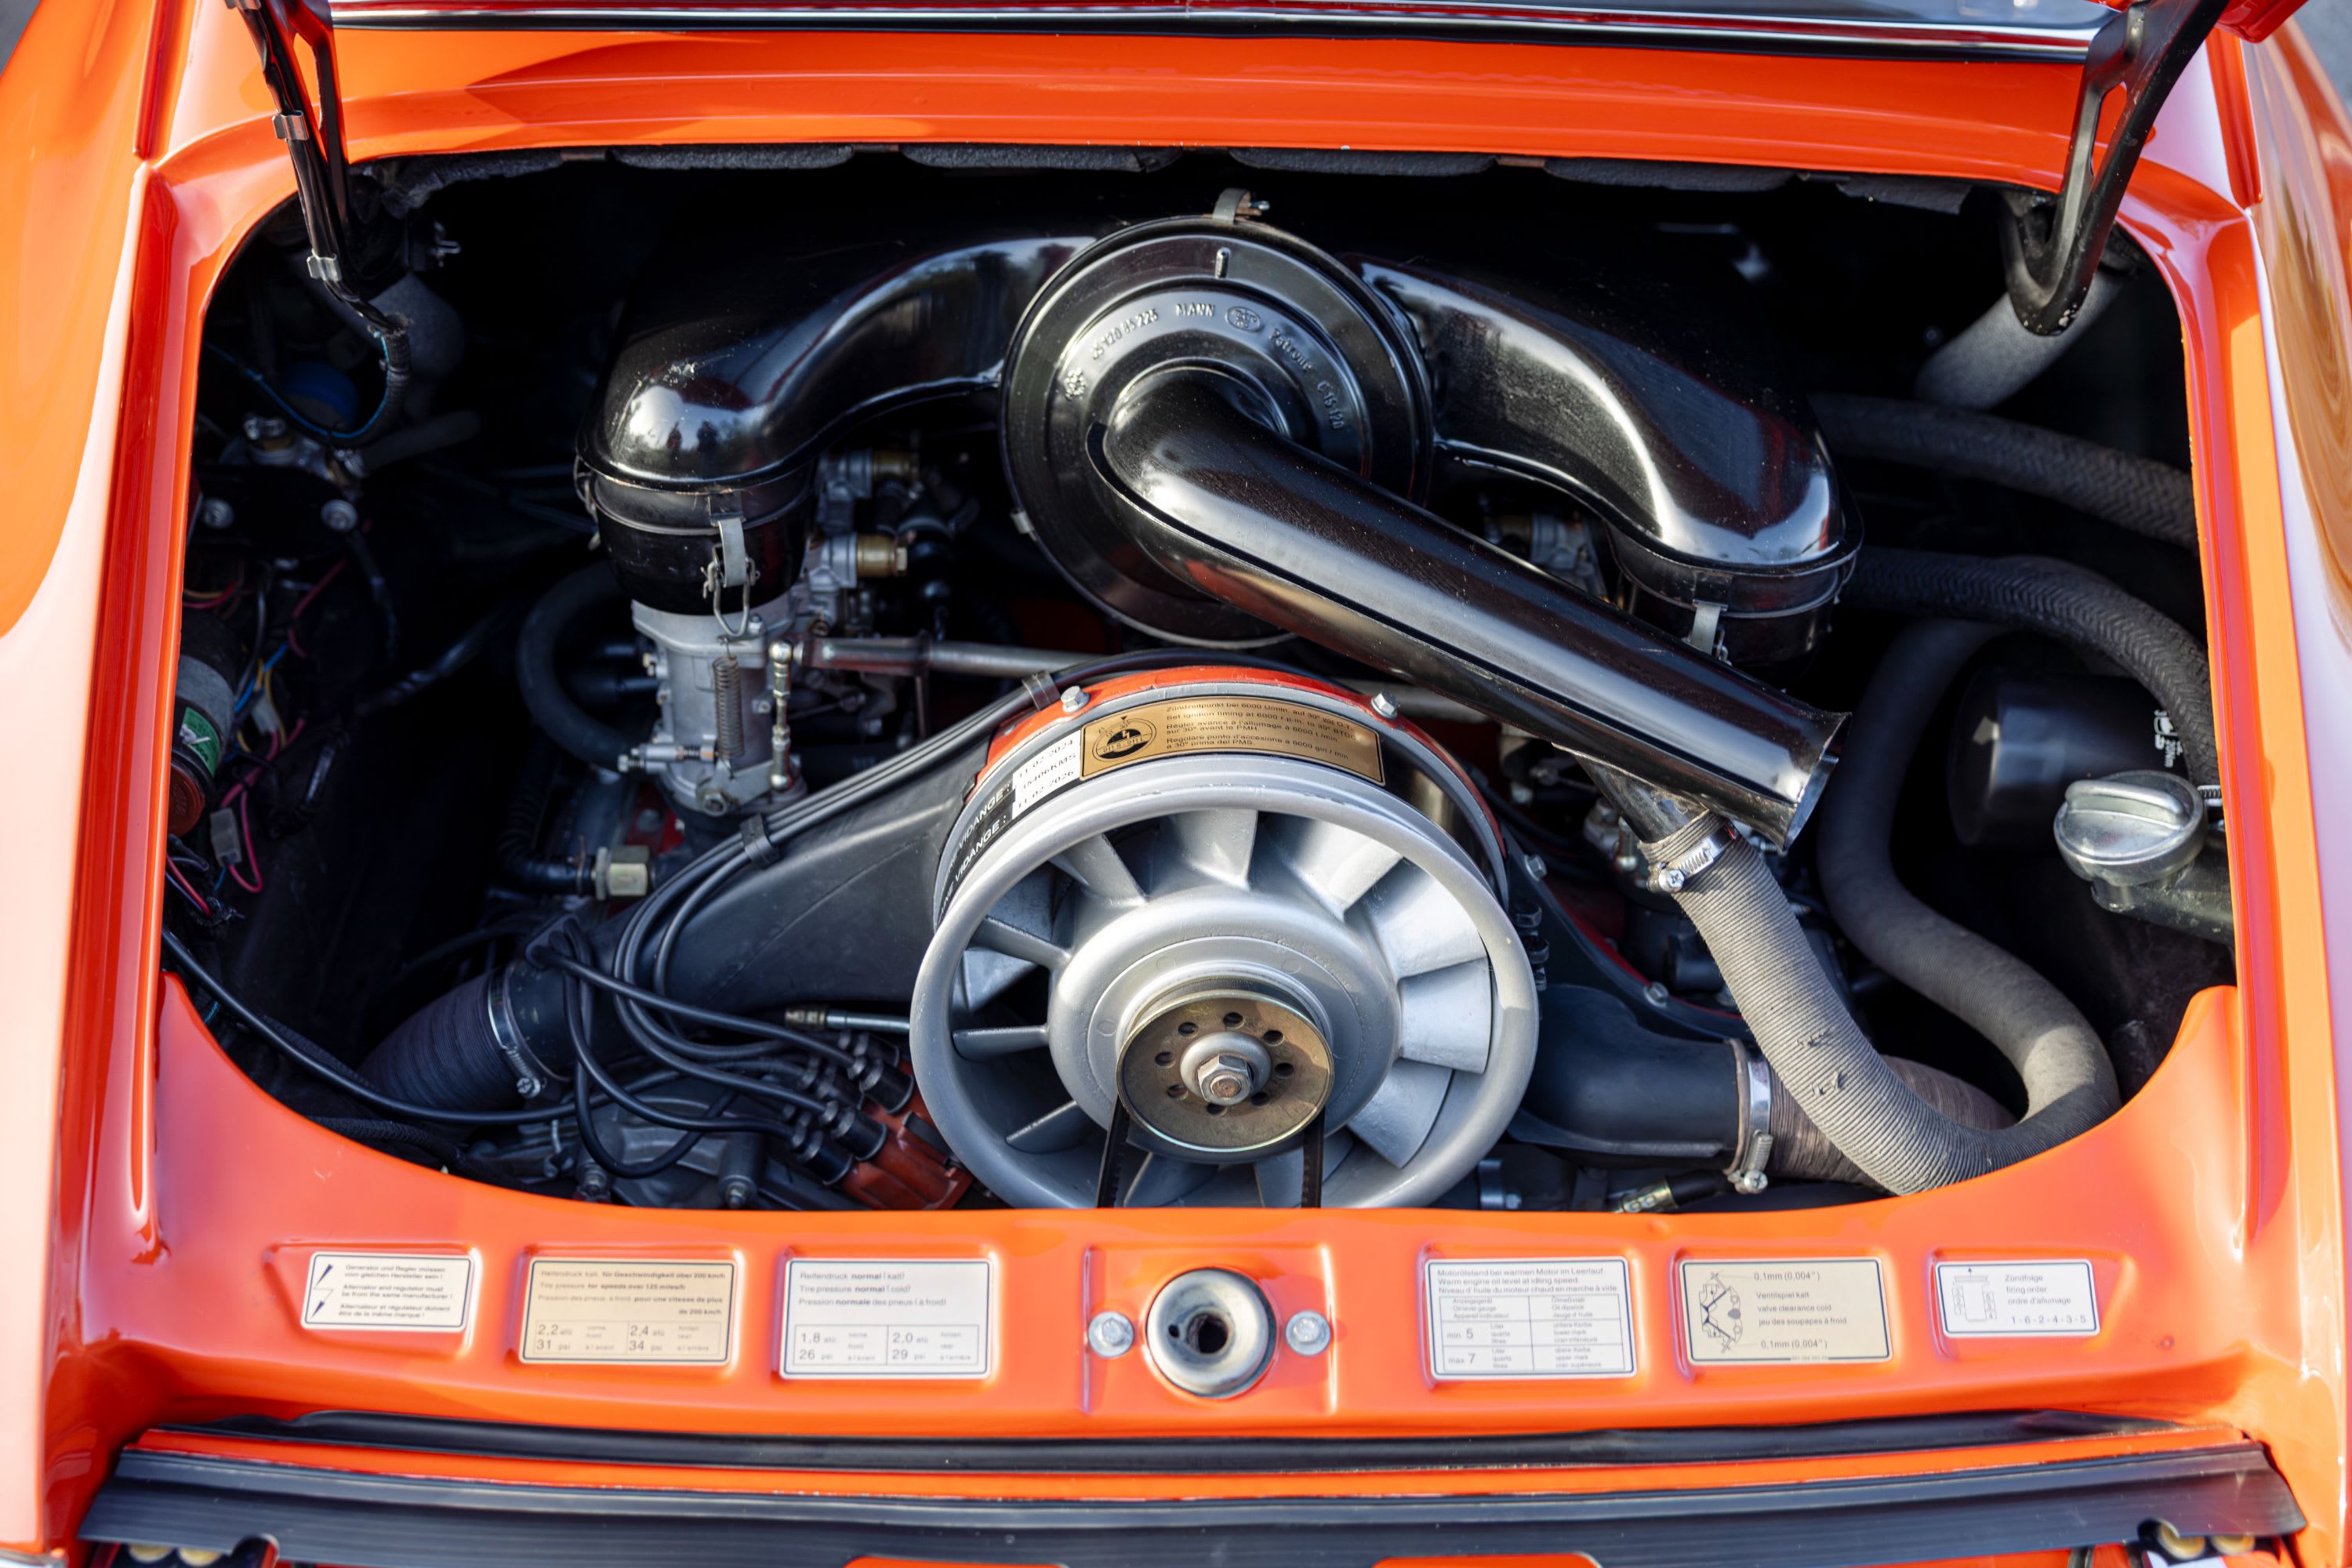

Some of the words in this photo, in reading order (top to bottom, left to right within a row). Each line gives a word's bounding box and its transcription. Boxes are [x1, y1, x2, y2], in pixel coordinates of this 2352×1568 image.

[1176, 303, 1215, 318] MANN
[2005, 1274, 2043, 1283] Zündfolge
[2006, 1285, 2026, 1294] firing
[1756, 1291, 1795, 1300] Ventilspiel
[2008, 1297, 2028, 1305] ordre
[2030, 1297, 2071, 1305] d'allumage
[1759, 1318, 1770, 1327] jeu
[538, 1324, 559, 1336] 2,2
[630, 1325, 648, 1338] 2,4
[1467, 1328, 1473, 1339] 5
[802, 1332, 820, 1344] 1,8
[536, 1339, 551, 1350] 31
[629, 1341, 644, 1351] 34
[799, 1348, 815, 1360] 26
[892, 1348, 909, 1360] 29
[1468, 1352, 1475, 1364] 7
